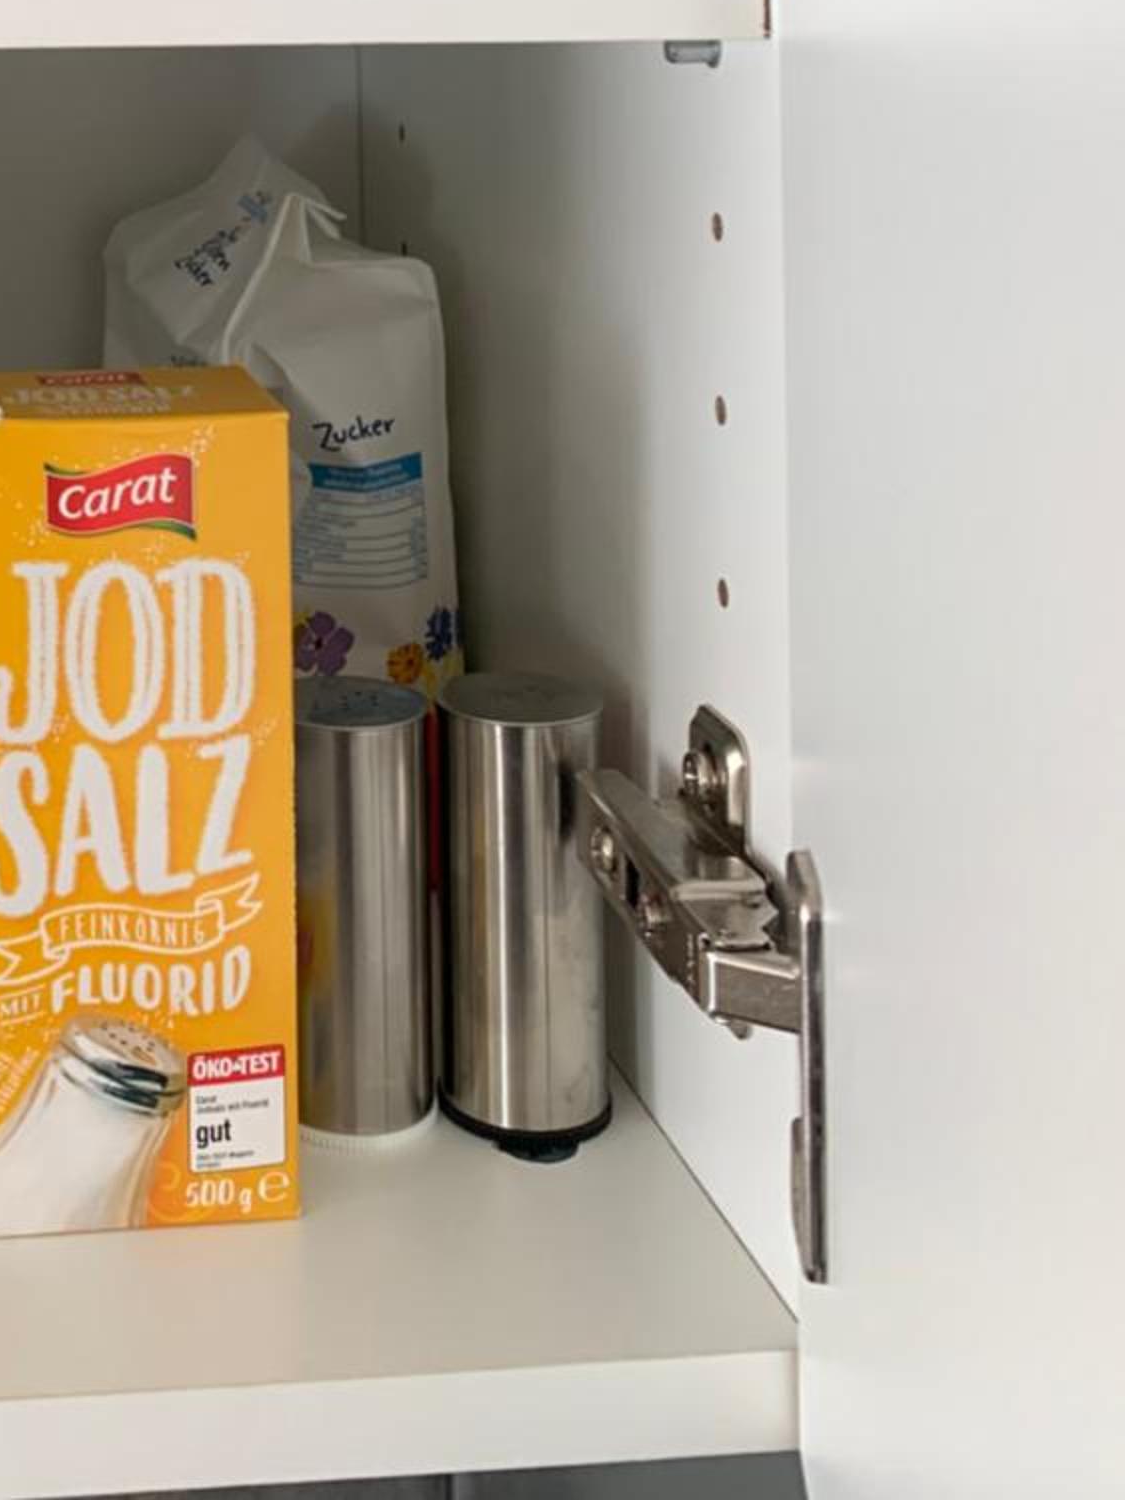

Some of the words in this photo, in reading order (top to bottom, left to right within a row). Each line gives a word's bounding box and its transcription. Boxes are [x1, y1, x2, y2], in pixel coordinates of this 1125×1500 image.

[312, 415, 396, 452] Zucker
[58, 466, 177, 520] Carat
[50, 944, 252, 1017] FLUORID
[196, 1118, 232, 1150] gut
[185, 1177, 235, 1210] 500
[239, 1187, 253, 1214] g
